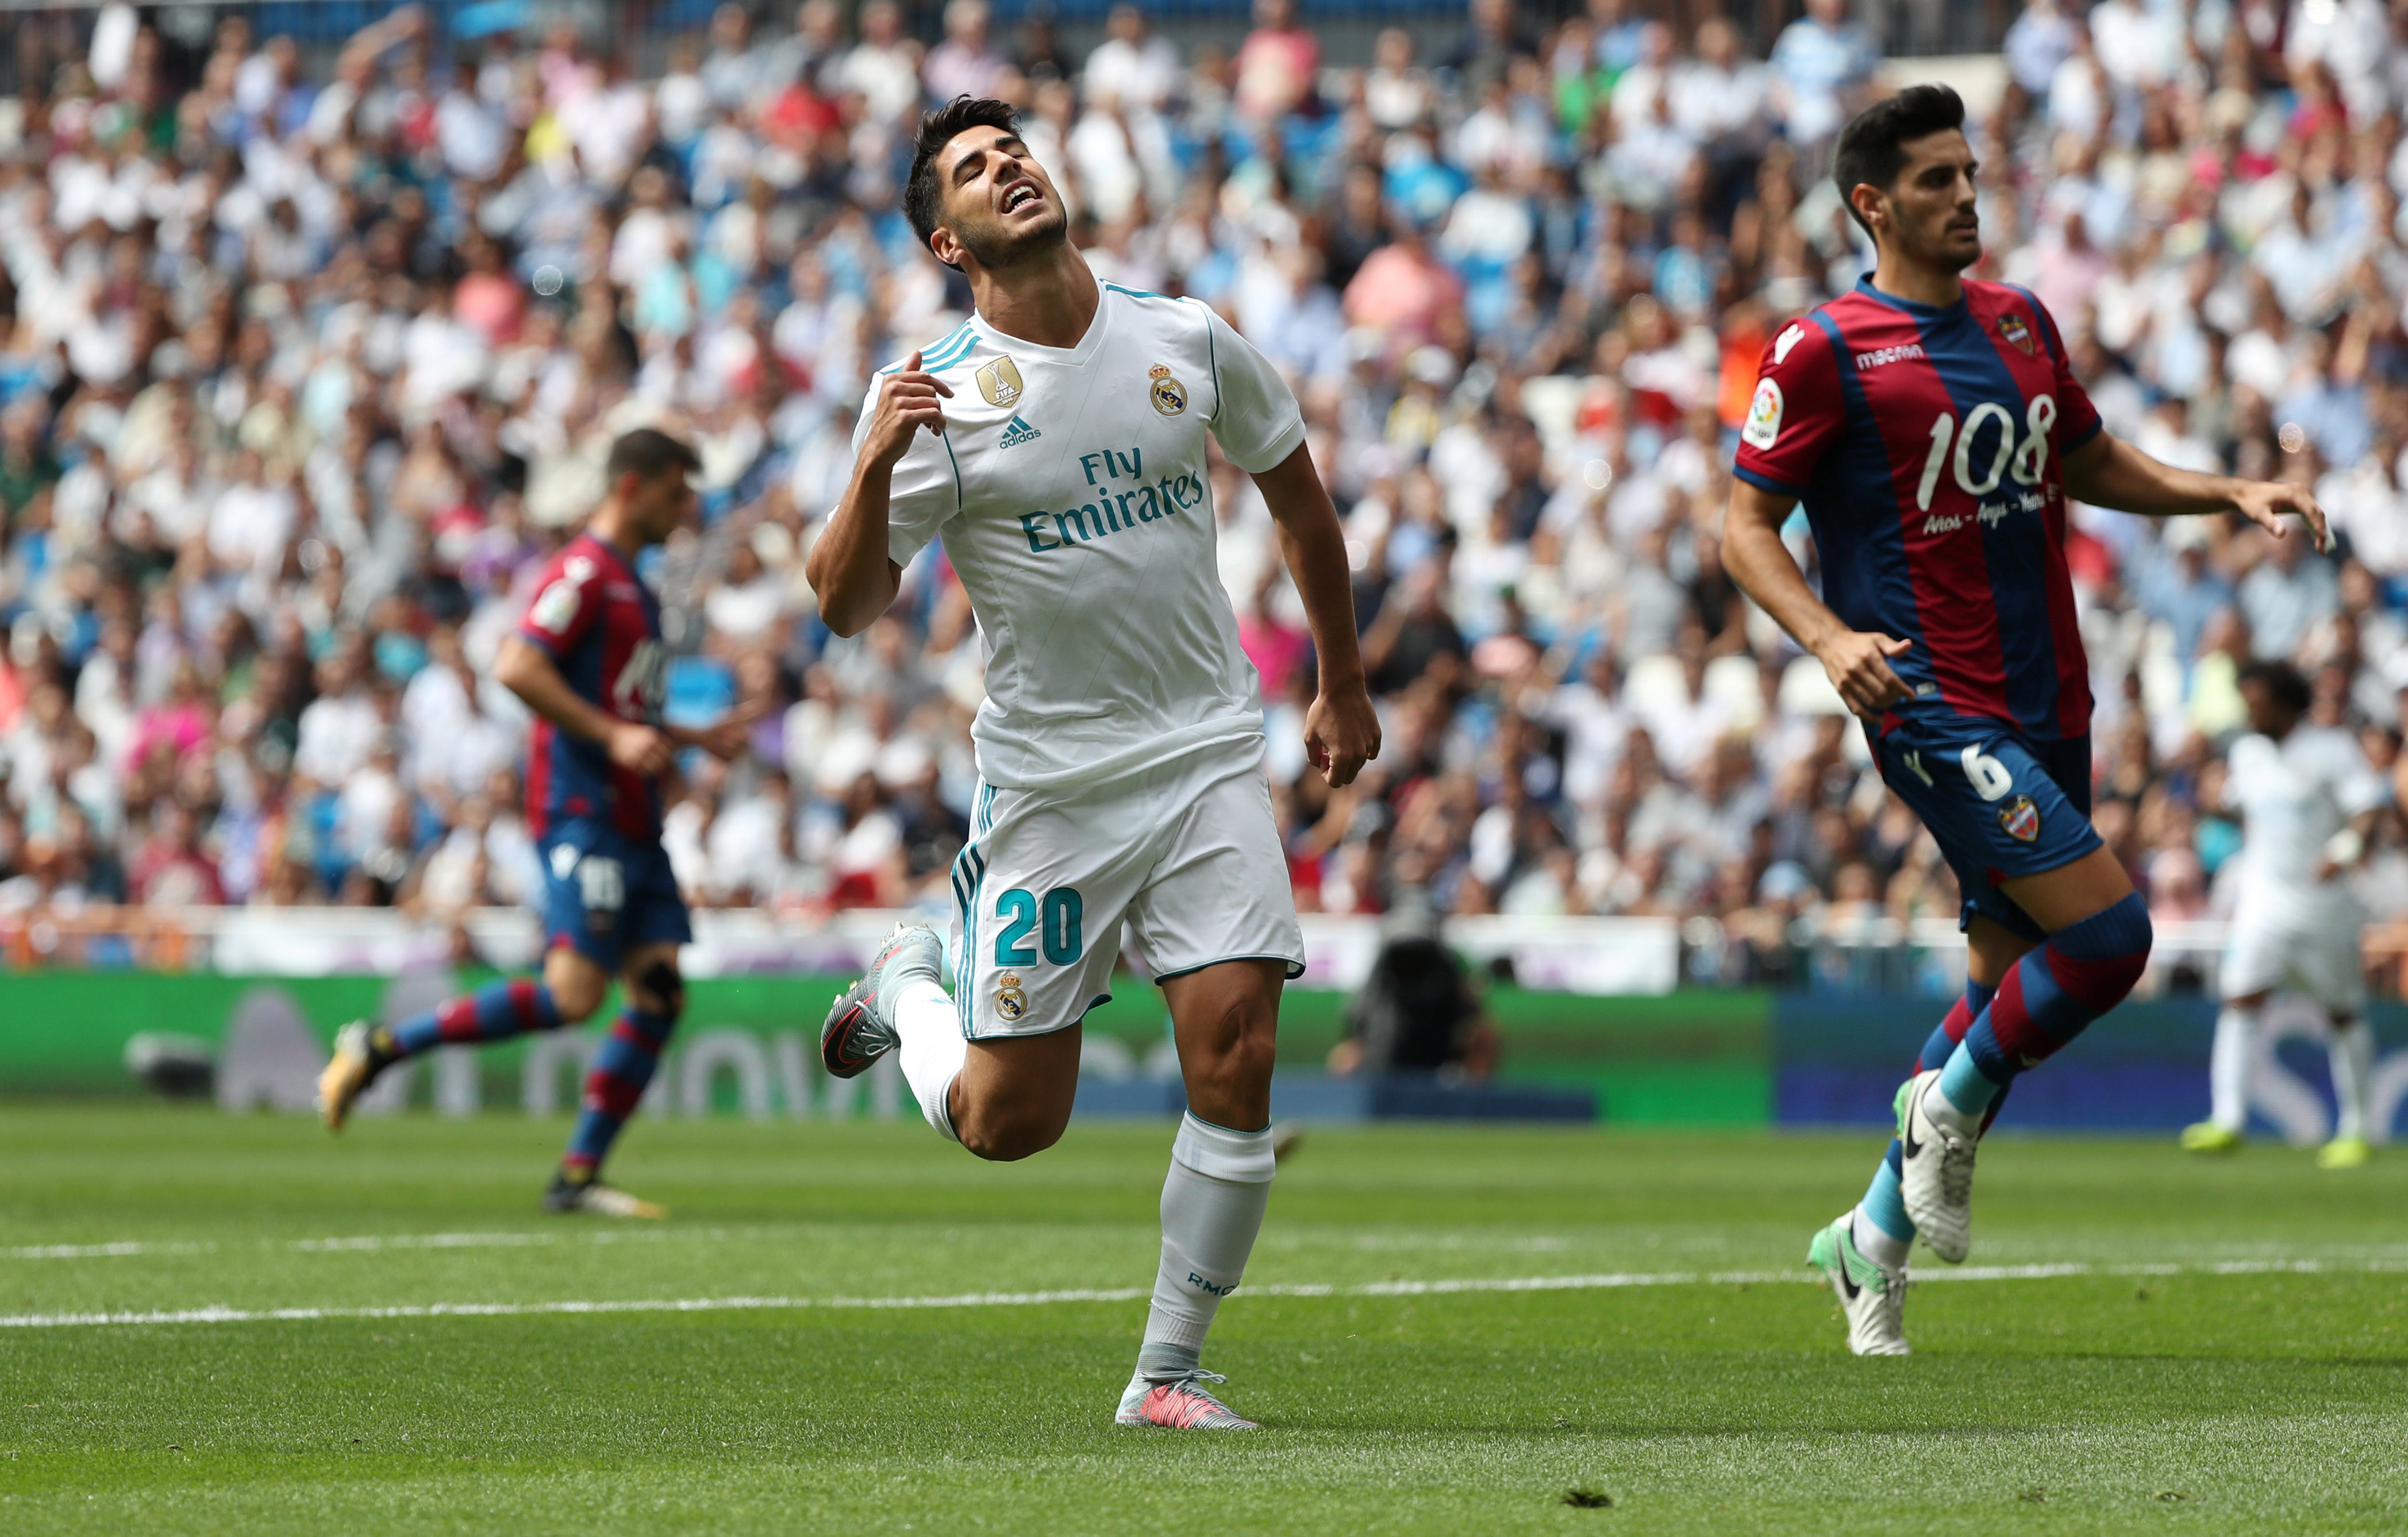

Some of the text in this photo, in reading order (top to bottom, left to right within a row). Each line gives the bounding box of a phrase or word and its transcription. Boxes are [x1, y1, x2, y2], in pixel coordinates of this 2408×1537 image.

[1856, 344, 1924, 371] macron
[995, 387, 1015, 399] FIFA
[1002, 397, 1014, 405] 2016
[999, 429, 1041, 449] adidas
[1916, 394, 2056, 511] 108
[1079, 447, 1142, 486] Fly
[1018, 469, 1203, 553] Emirates
[1960, 742, 2012, 802] 6
[994, 887, 1083, 967] 20
[1187, 1272, 1240, 1296] RMC
